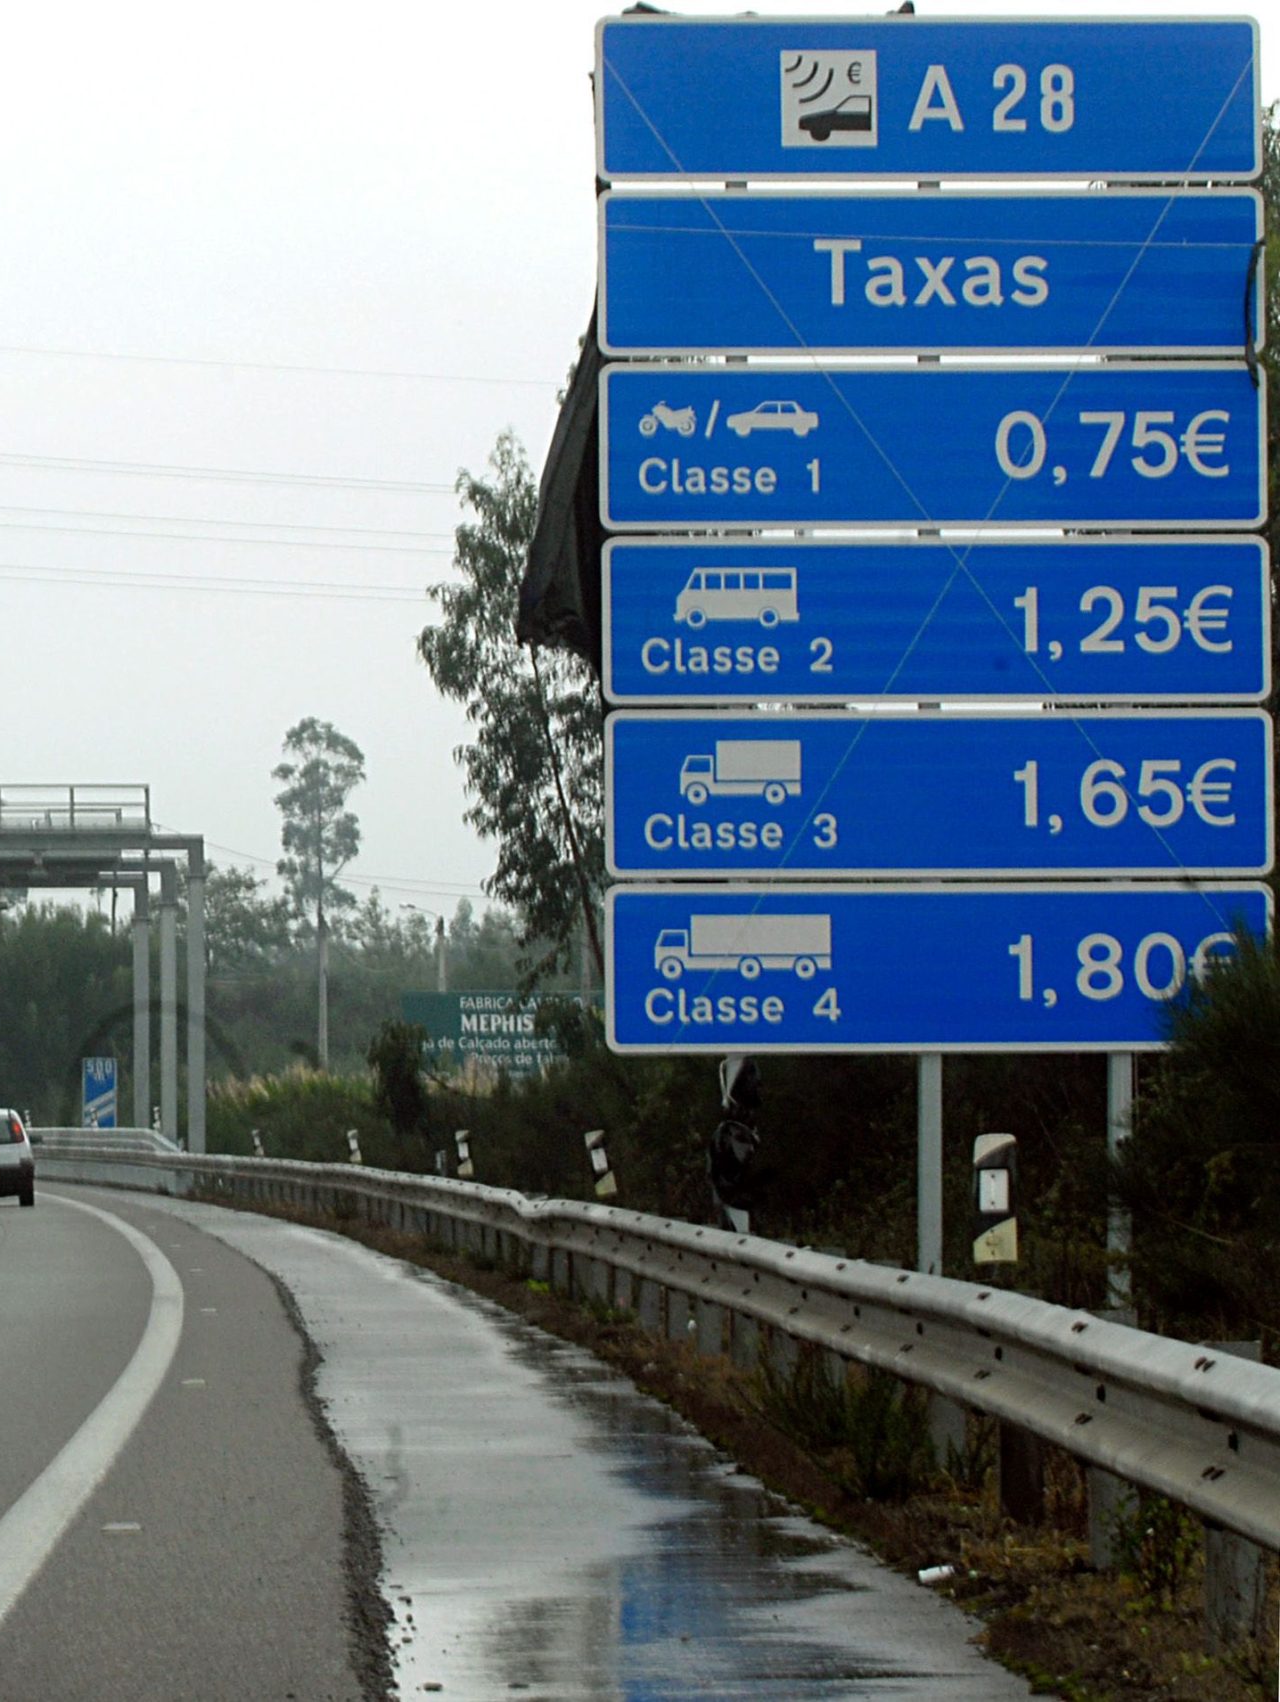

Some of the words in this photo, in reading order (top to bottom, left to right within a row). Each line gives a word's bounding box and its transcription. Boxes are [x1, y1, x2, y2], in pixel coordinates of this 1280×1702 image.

[908, 64, 964, 132] A
[992, 64, 1075, 132] 28
[813, 238, 1049, 306] Taxas
[995, 410, 1230, 485] 0,75€
[638, 457, 777, 493] Classe
[806, 458, 820, 492] 1
[1013, 585, 1233, 660] 1,25€
[641, 637, 780, 673] Classe
[809, 637, 833, 672] 2
[1013, 758, 1236, 834] 1,65€
[644, 813, 783, 849] Classe
[813, 813, 837, 848] 3
[461, 1013, 556, 1033] MEPHIS
[644, 988, 784, 1023] Classe
[813, 988, 841, 1021] 4
[438, 1036, 455, 1049] de
[458, 1036, 510, 1051] Calçado
[515, 1052, 533, 1064] de
[86, 1059, 113, 1073] 500
